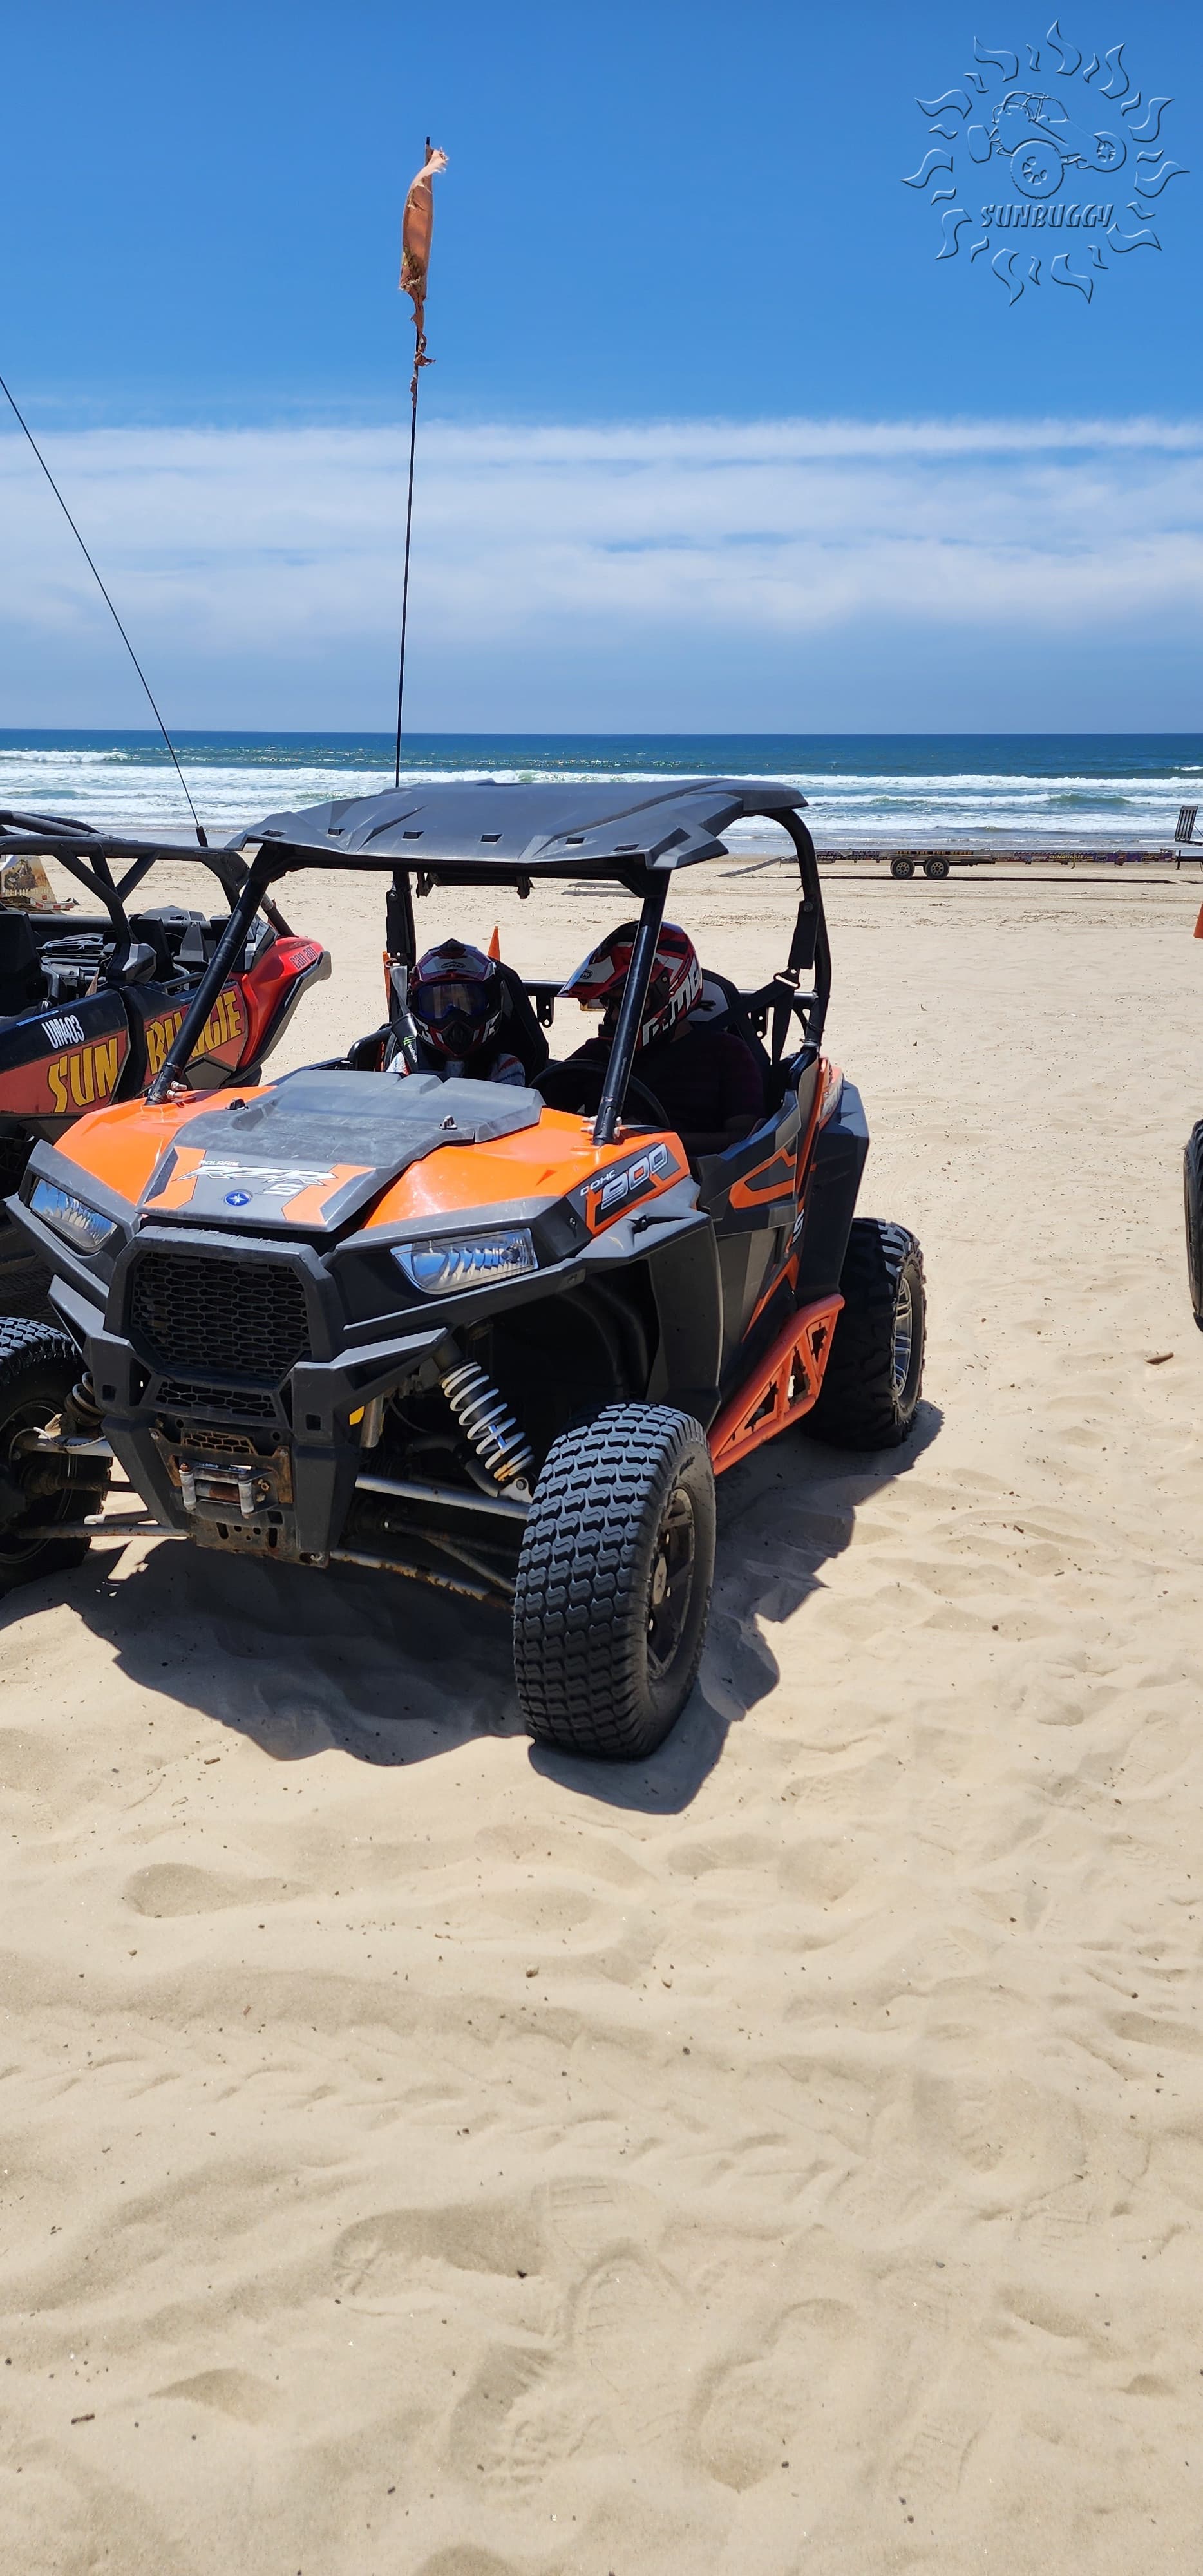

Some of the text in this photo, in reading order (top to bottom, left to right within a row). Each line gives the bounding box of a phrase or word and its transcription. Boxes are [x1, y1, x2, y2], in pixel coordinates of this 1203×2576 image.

[41, 1014, 85, 1049] UM403
[48, 1037, 118, 1113] SUN
[171, 1165, 339, 1186] RZR
[260, 1182, 307, 1197] S
[580, 1169, 616, 1197] DOHC
[601, 1143, 668, 1210] 900
